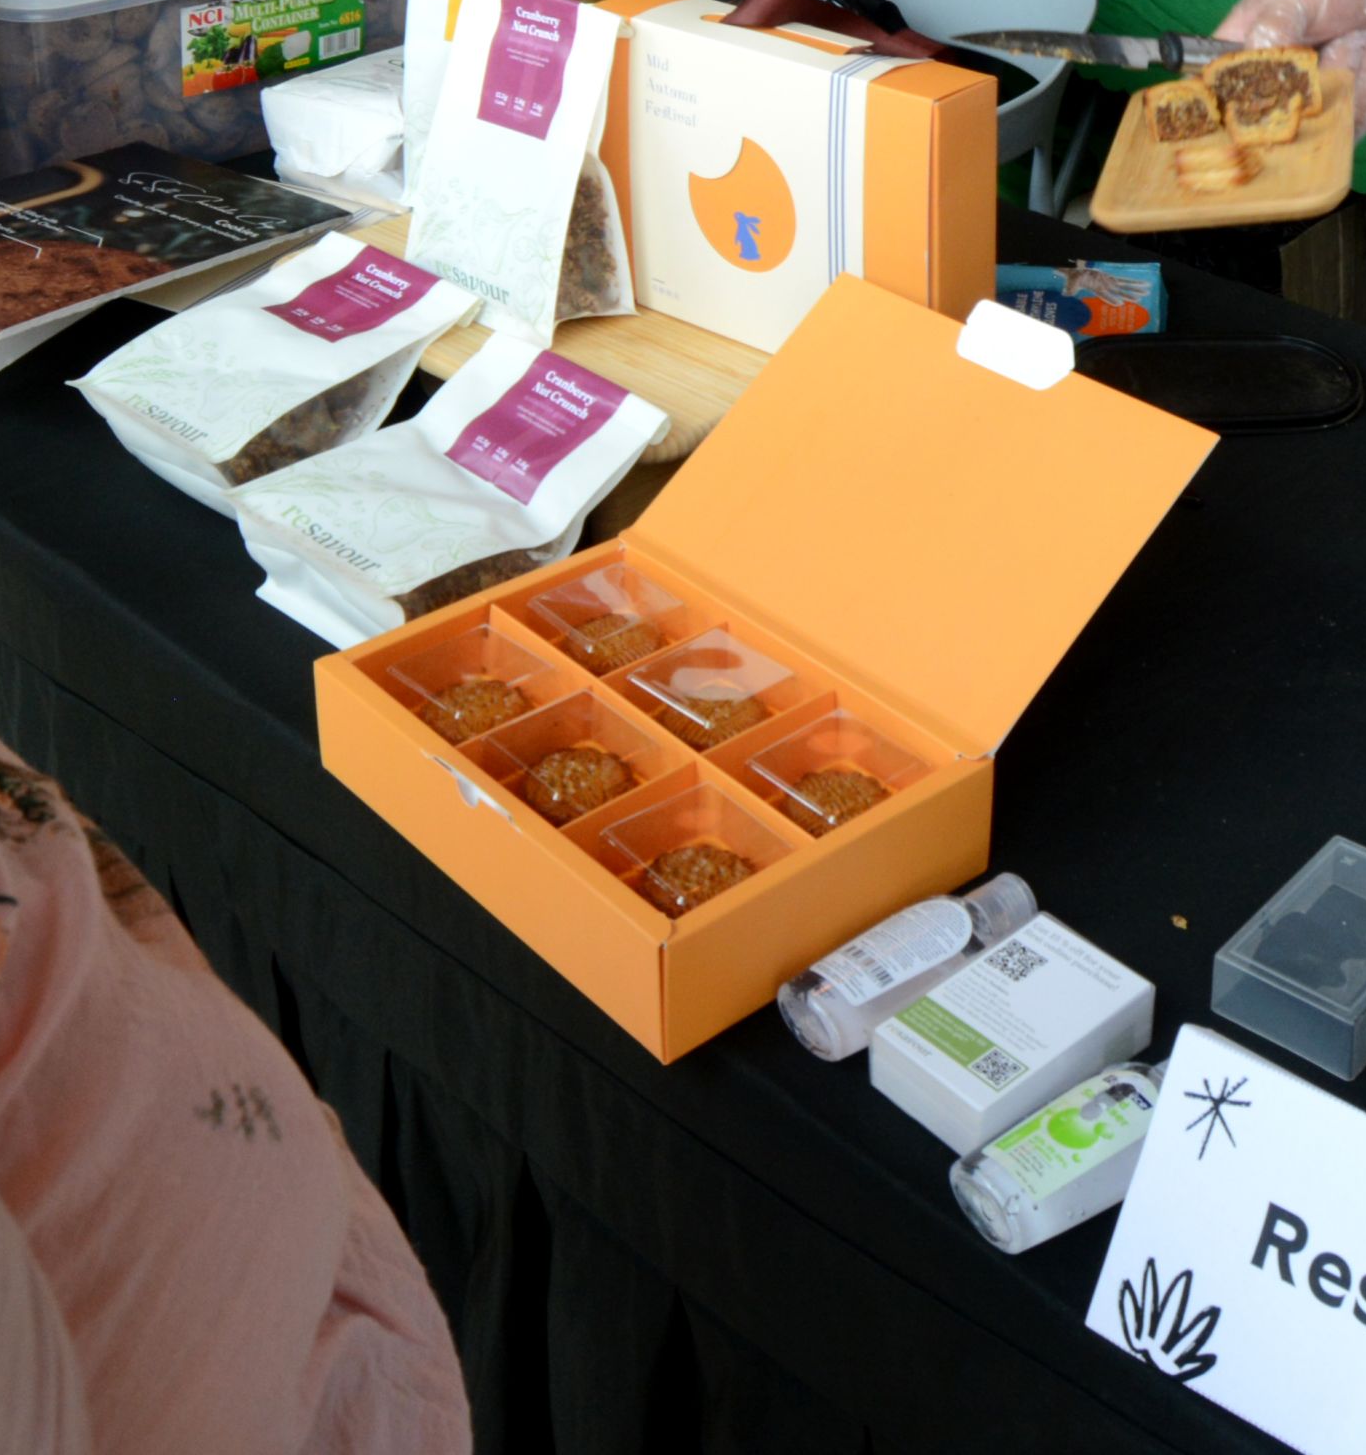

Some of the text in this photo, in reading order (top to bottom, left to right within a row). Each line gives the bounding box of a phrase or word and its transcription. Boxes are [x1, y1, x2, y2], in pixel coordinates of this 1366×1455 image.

[189, 8, 223, 28] NCI
[252, 8, 319, 33] CONTAINER
[511, 20, 560, 42] Nut Crunch
[516, 6, 561, 29] Cranberry
[646, 53, 669, 72] Mid
[647, 77, 697, 104] Autumn
[645, 99, 698, 128] Festival
[215, 219, 260, 238] Cookies
[352, 272, 369, 285] Nut
[370, 280, 403, 299] Crunch
[366, 264, 411, 290] Cranberry
[435, 260, 509, 304] resavour
[532, 382, 551, 399] Nut
[550, 391, 589, 420] Crunch
[545, 370, 595, 406] Cranberry
[125, 394, 208, 442] resavour
[281, 505, 382, 571] resavour
